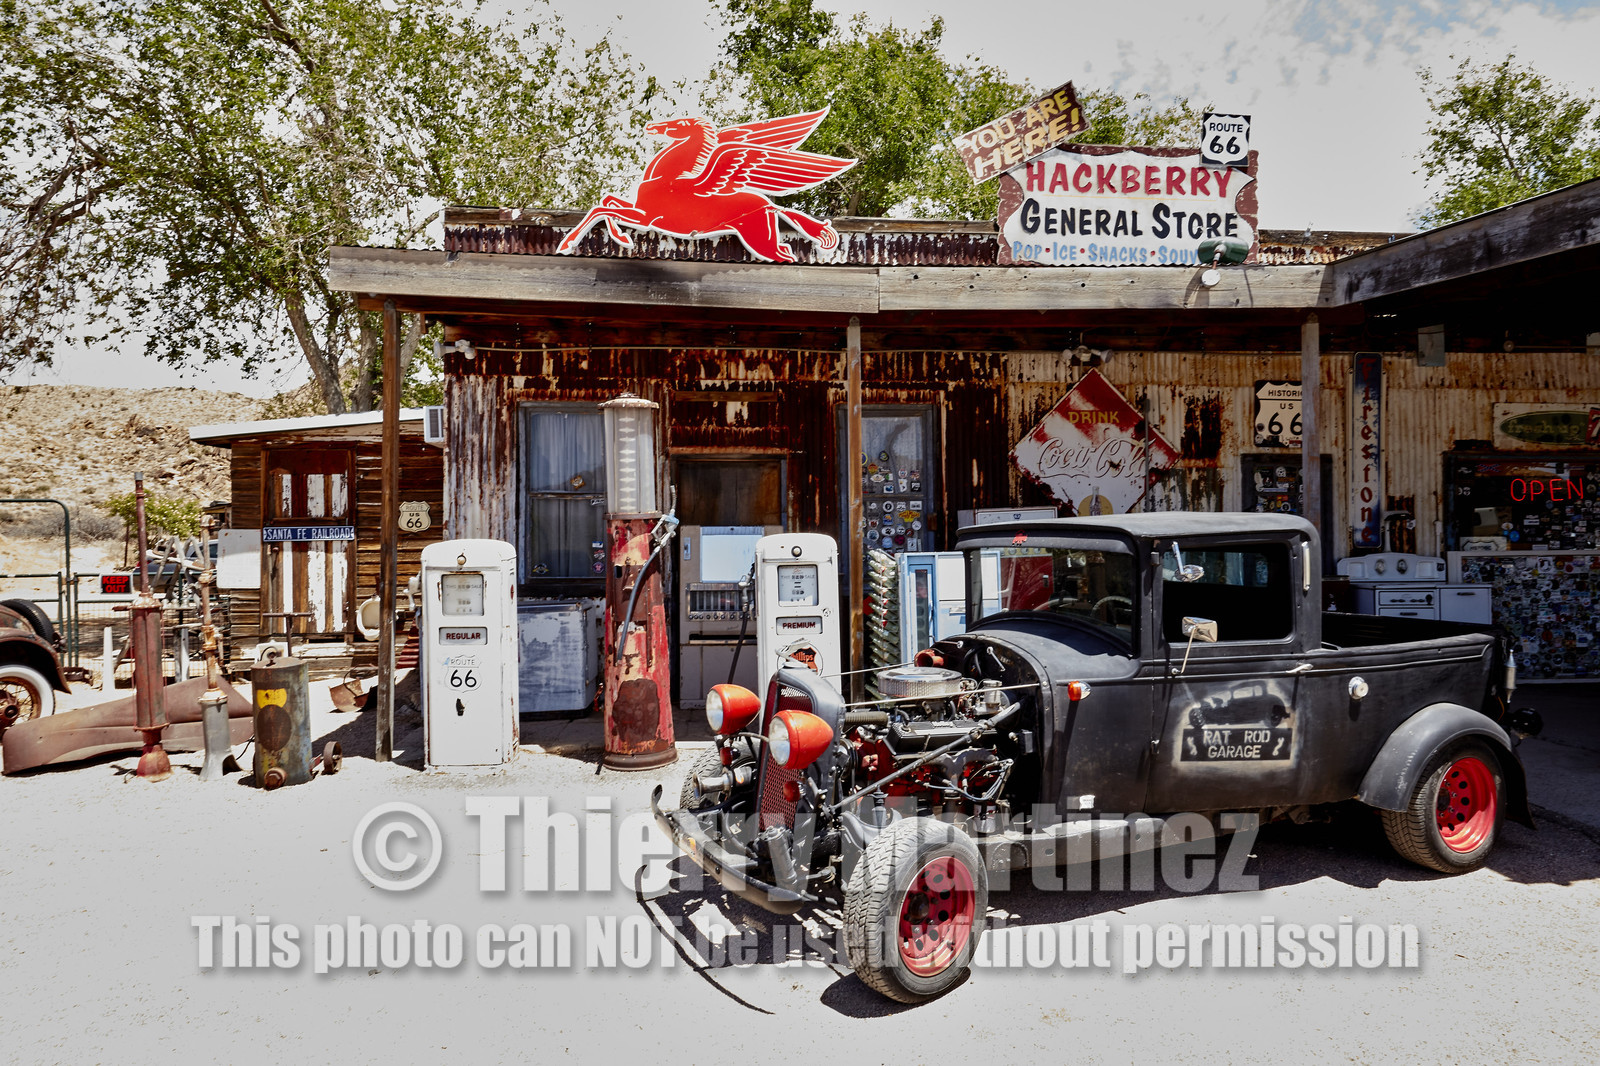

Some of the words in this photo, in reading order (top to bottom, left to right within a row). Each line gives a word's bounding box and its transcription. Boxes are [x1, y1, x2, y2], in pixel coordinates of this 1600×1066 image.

[961, 118, 1016, 154] YOU
[1026, 90, 1072, 128] ARE
[1209, 122, 1243, 132] ROUTE
[974, 107, 1080, 180] HERE!
[1209, 135, 1241, 154] 66
[1026, 160, 1233, 198] HACKBERRY
[1020, 197, 1143, 238] GENERAL
[1151, 202, 1238, 239] STORE
[1013, 240, 1042, 260] POP
[1053, 241, 1077, 260] ICE
[1088, 243, 1148, 263] SNACKS
[1158, 245, 1199, 264] SOUV
[1068, 411, 1120, 424] DRINK
[1268, 412, 1302, 436] 66
[1358, 357, 1377, 543] Firestone
[1510, 477, 1584, 502] OPEN
[406, 518, 422, 529] 66
[267, 528, 292, 540] SANTA
[297, 528, 307, 539] FE
[311, 527, 351, 540] RAILROAD
[102, 576, 129, 585] KEEP
[105, 584, 126, 593] OUT
[782, 621, 816, 629] PREMIUM
[445, 632, 481, 640] REGULAR
[450, 669, 477, 688] 66
[1203, 730, 1231, 745] RAT
[1244, 729, 1271, 744] ROD
[1207, 745, 1262, 758] GARAGE
